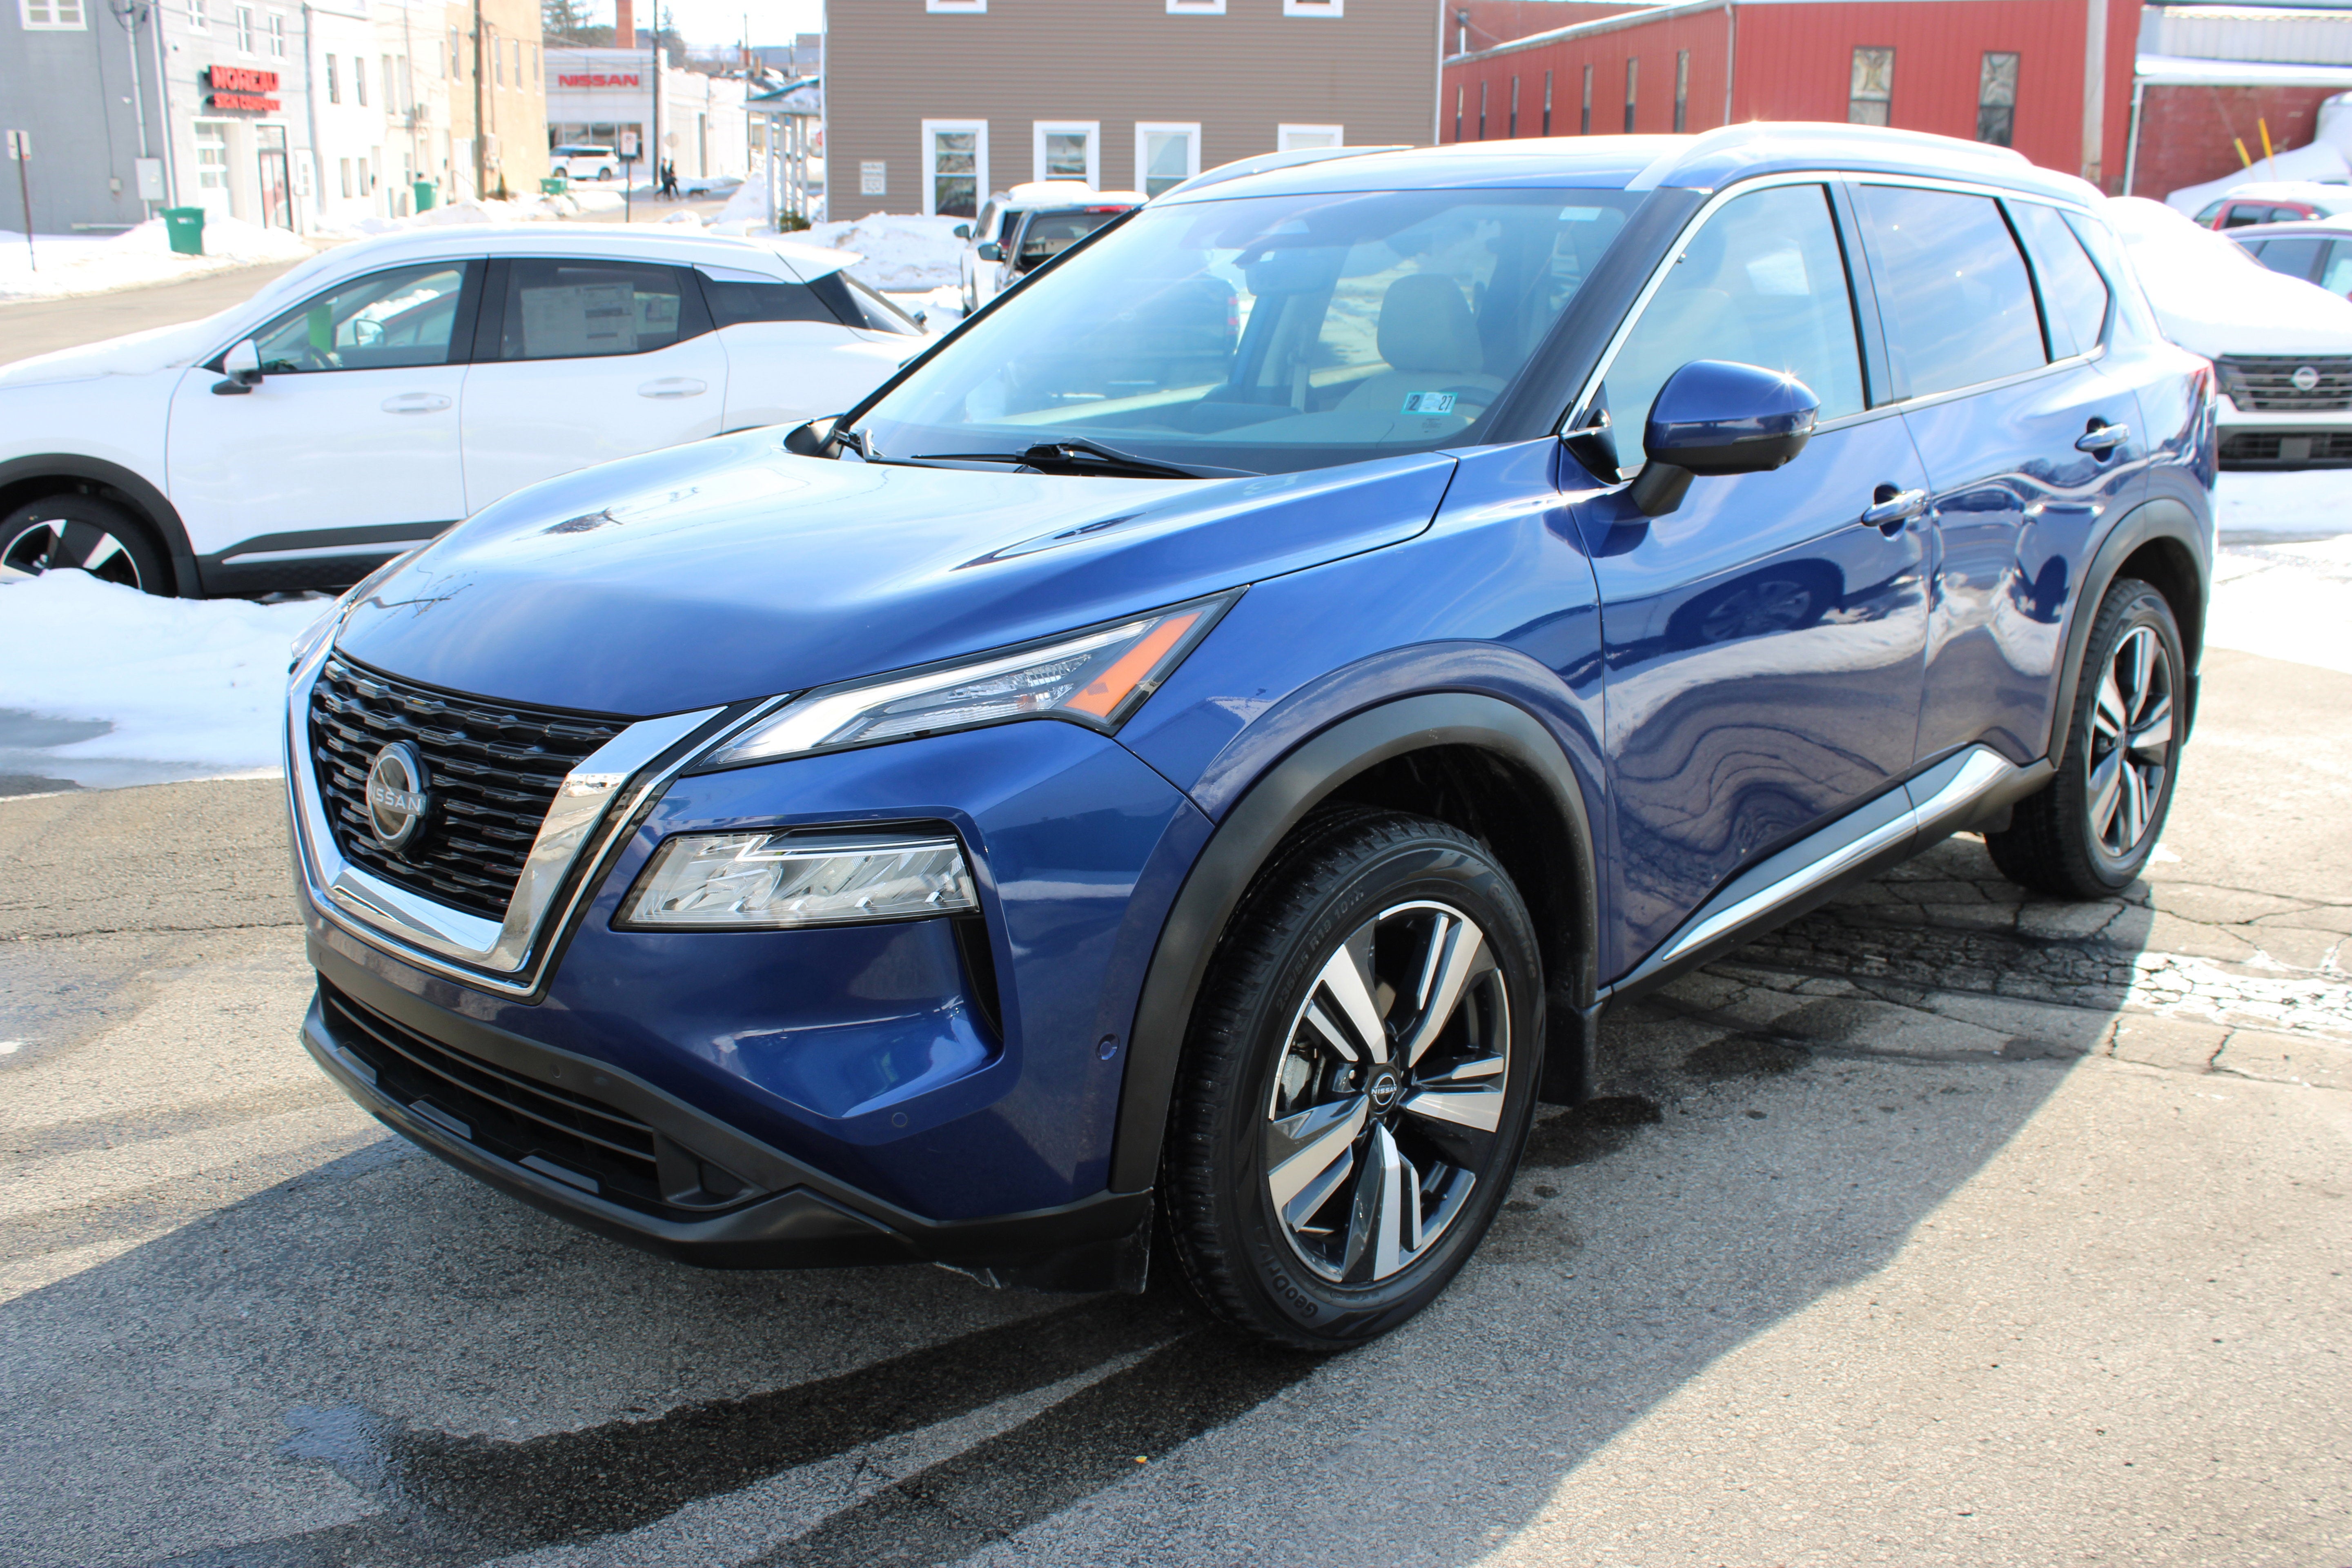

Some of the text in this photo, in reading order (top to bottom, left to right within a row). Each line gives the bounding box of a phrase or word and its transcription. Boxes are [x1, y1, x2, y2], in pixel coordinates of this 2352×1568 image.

[559, 75, 638, 87] NISSAN
[1408, 394, 1453, 411] 2 27
[1276, 951, 1309, 1012] 235/55
[1310, 920, 1332, 952] R19
